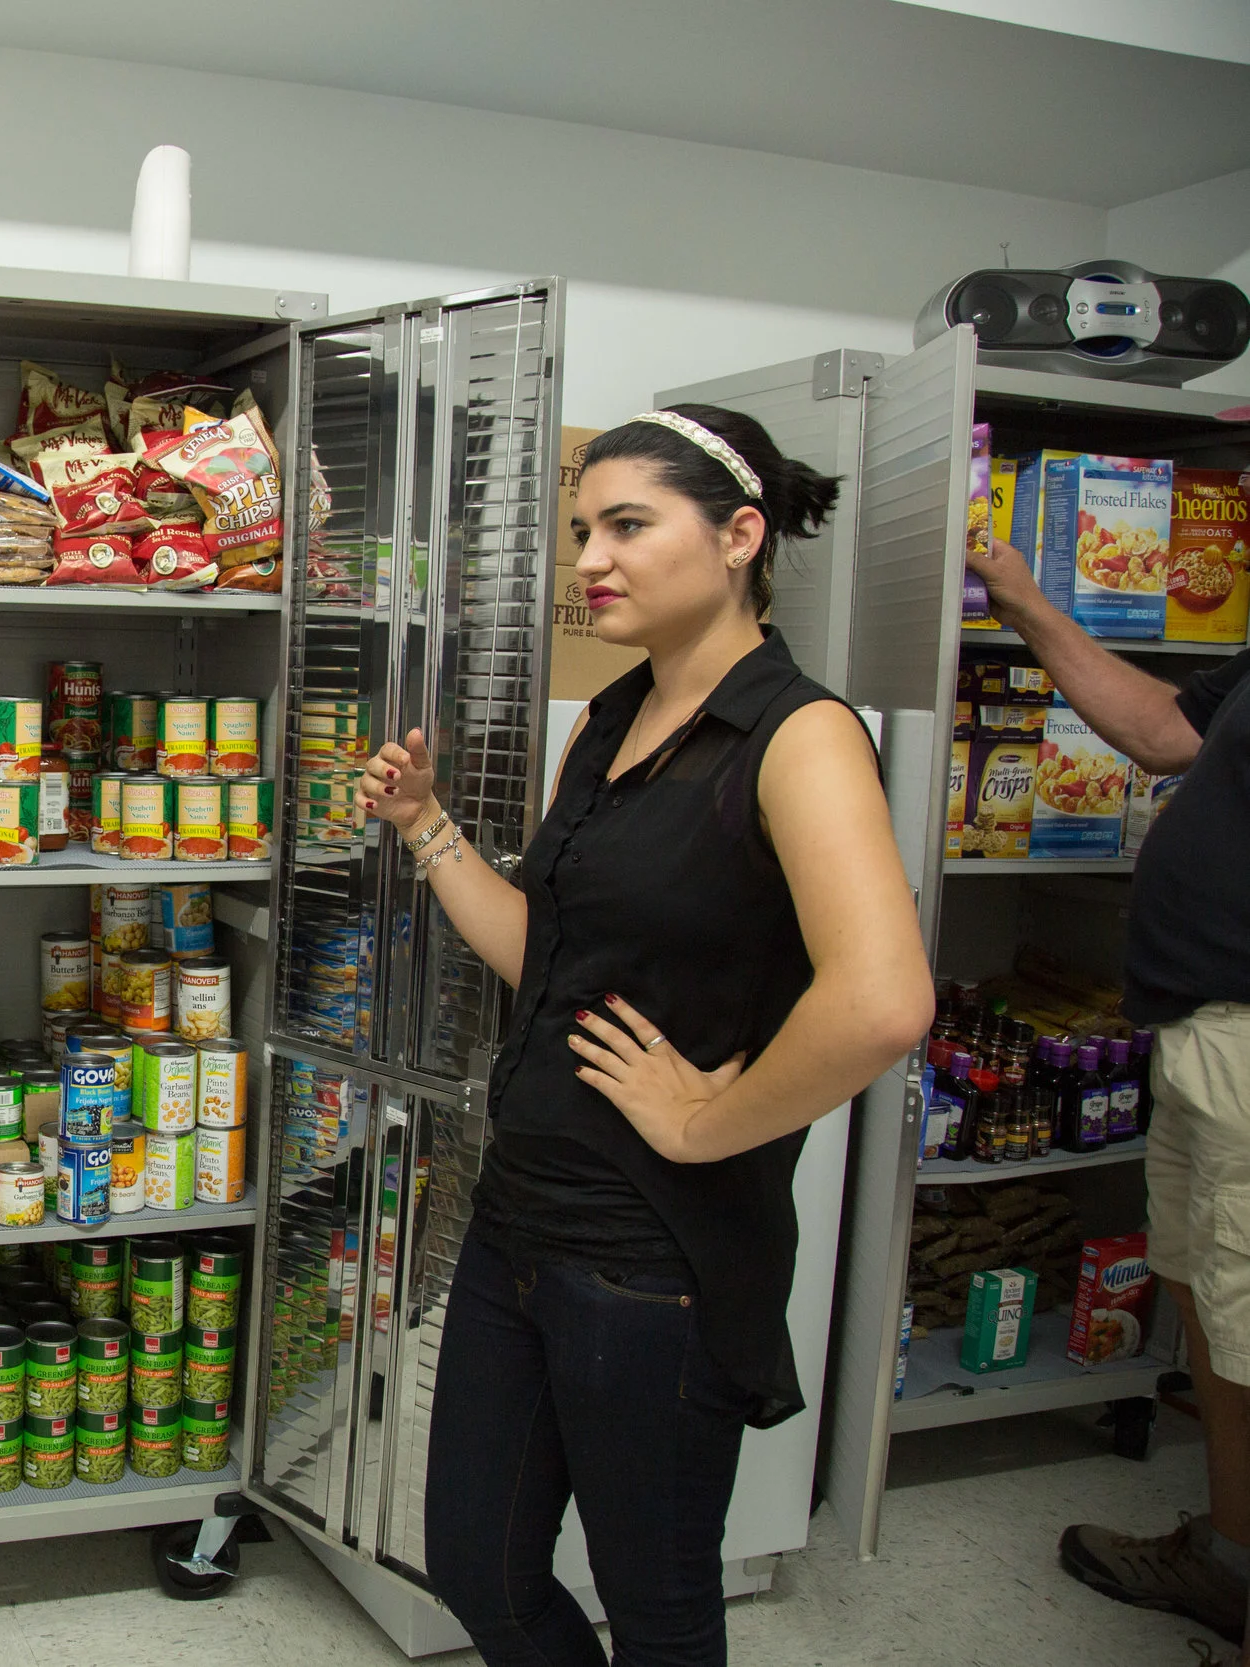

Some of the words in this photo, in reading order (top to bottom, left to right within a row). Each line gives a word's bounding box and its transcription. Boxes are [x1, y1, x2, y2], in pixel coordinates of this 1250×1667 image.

[183, 425, 230, 458] SENECA
[1133, 465, 1158, 474] SAFEWAY
[217, 473, 245, 491] CRISPY
[1142, 473, 1168, 483] kitchens
[1192, 483, 1219, 499] Honey
[1222, 483, 1240, 497] Nut
[1084, 489, 1127, 508] Frosted
[1129, 491, 1168, 510] Flakes
[1170, 490, 1248, 522] Cheerios
[215, 500, 273, 531] CHIPS
[167, 528, 201, 539] Recipe
[217, 525, 277, 548] ORIGINAL
[1206, 528, 1233, 538] OATS
[562, 628, 584, 637] PURE
[64, 682, 101, 696] Hunt's
[1046, 719, 1088, 735] Frosted
[988, 767, 1033, 777] Multi-Grain
[982, 774, 1034, 802] Crisps
[184, 804, 214, 814] Spaghetti
[132, 812, 151, 820] Sauce
[189, 813, 209, 821] Sauce
[1009, 824, 1025, 832] Original
[50, 964, 75, 974] Butter
[182, 975, 218, 985] HANOVER
[164, 1063, 192, 1076] Organic
[203, 1058, 232, 1072] Organic
[74, 1066, 114, 1085] GOYA
[206, 1078, 228, 1087] Pinto
[80, 1088, 96, 1096] Black
[200, 1153, 220, 1164] Pinto
[1097, 1259, 1150, 1293] Minut
[206, 1280, 231, 1290] BEANS
